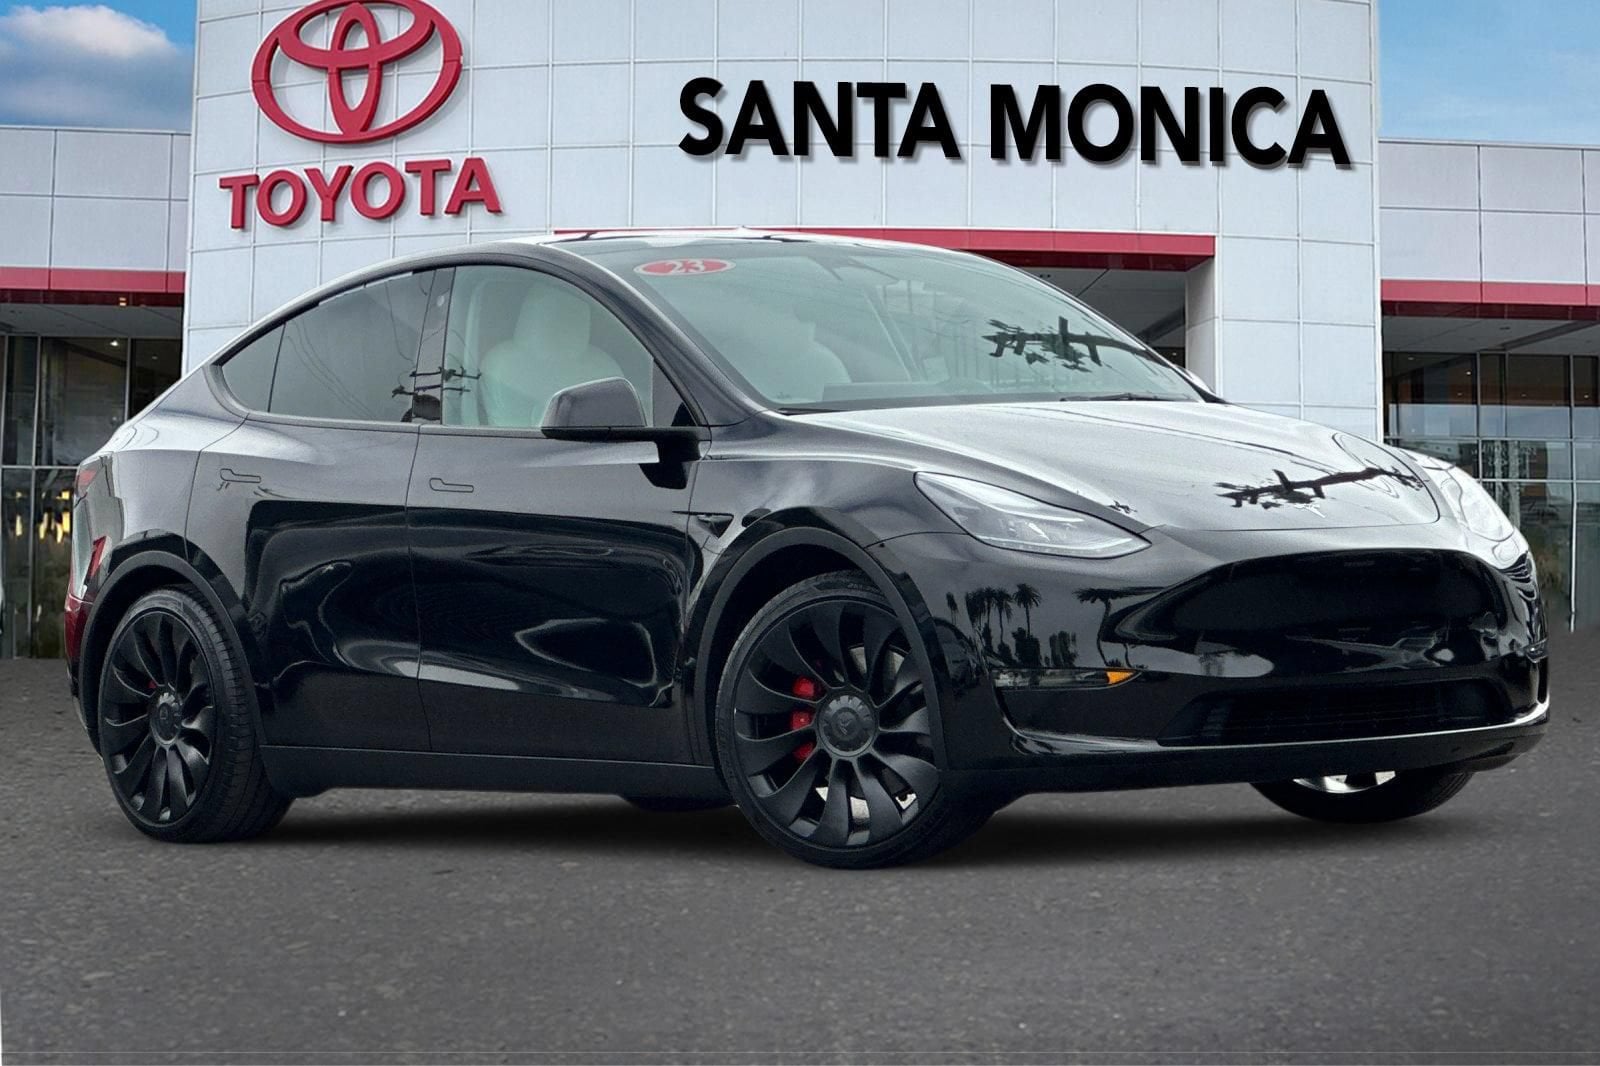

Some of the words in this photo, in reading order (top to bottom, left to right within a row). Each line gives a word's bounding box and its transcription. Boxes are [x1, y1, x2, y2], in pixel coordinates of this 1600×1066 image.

[679, 78, 960, 157] SANTA
[991, 84, 1350, 168] MONICA
[219, 157, 502, 229] TOYOTA
[665, 260, 705, 273] 23
